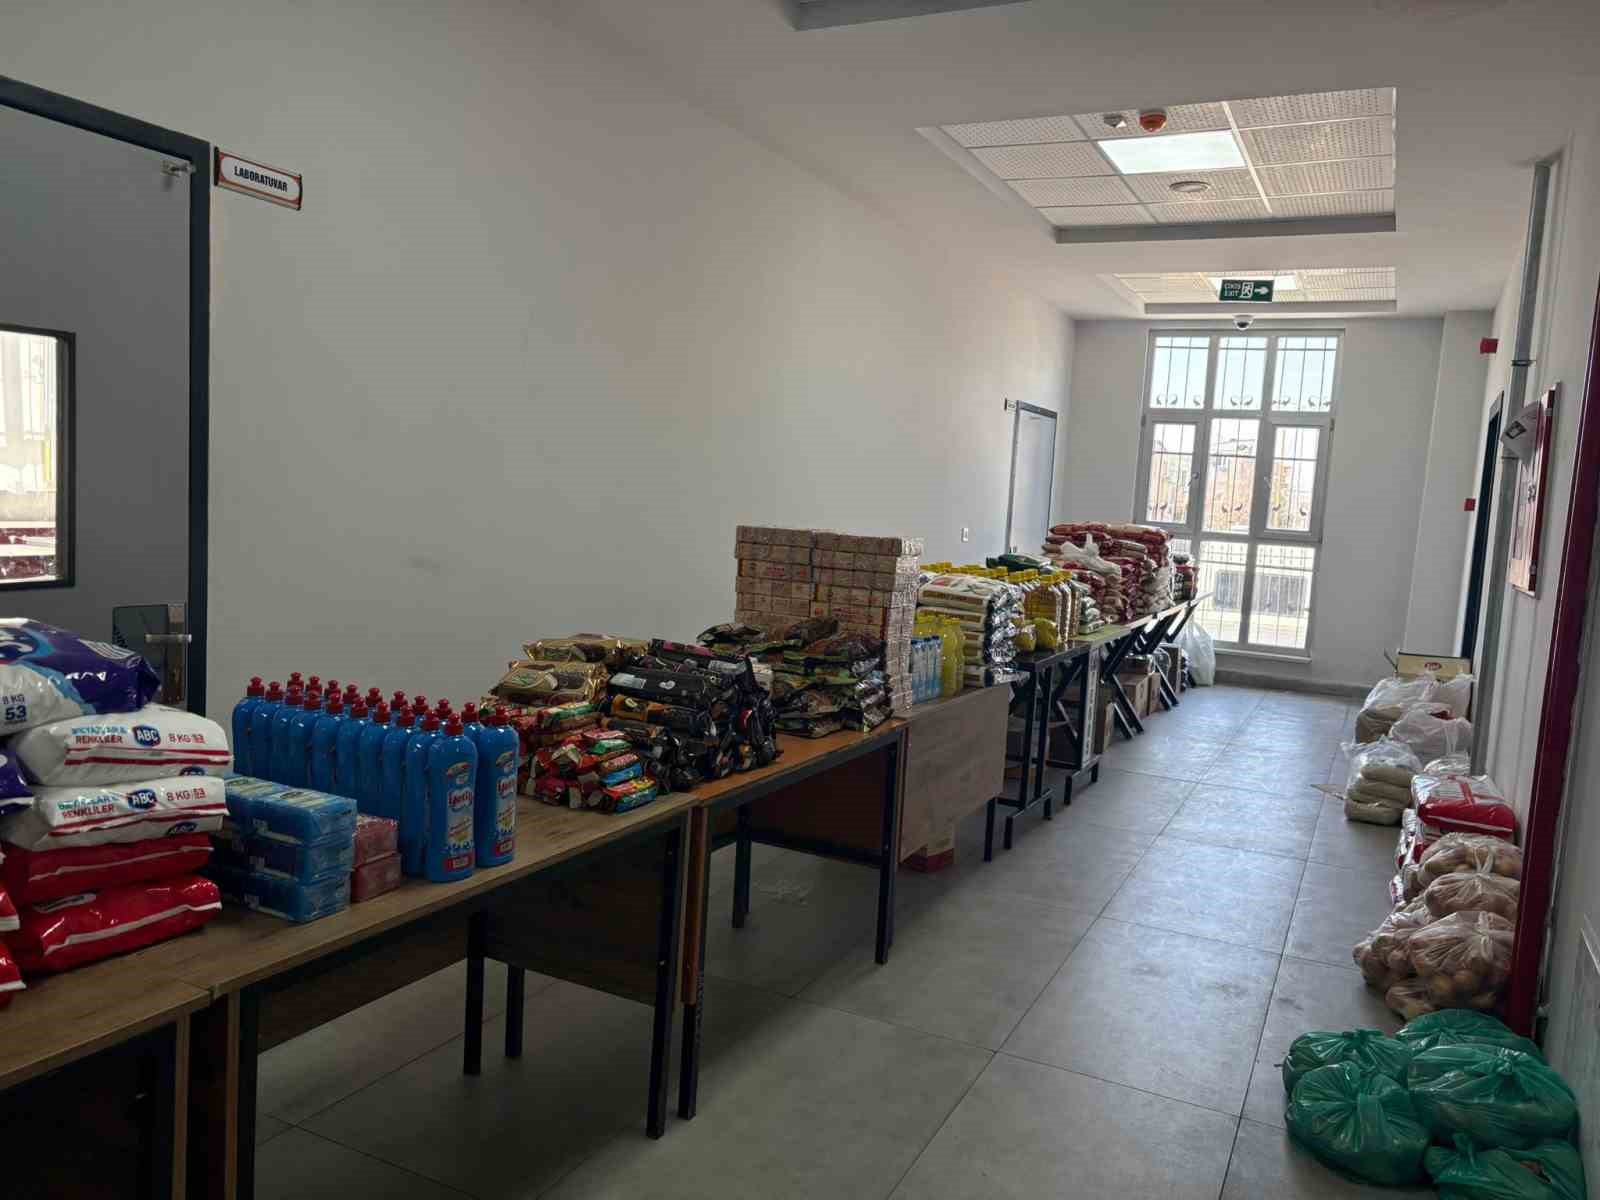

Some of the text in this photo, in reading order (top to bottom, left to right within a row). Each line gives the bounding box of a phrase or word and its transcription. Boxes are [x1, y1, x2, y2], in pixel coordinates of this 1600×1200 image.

[234, 166, 288, 192] LABORATUVAR
[5, 705, 27, 721] 53
[136, 728, 159, 742] ABC
[131, 791, 154, 808] ABC
[175, 791, 191, 801] KG
